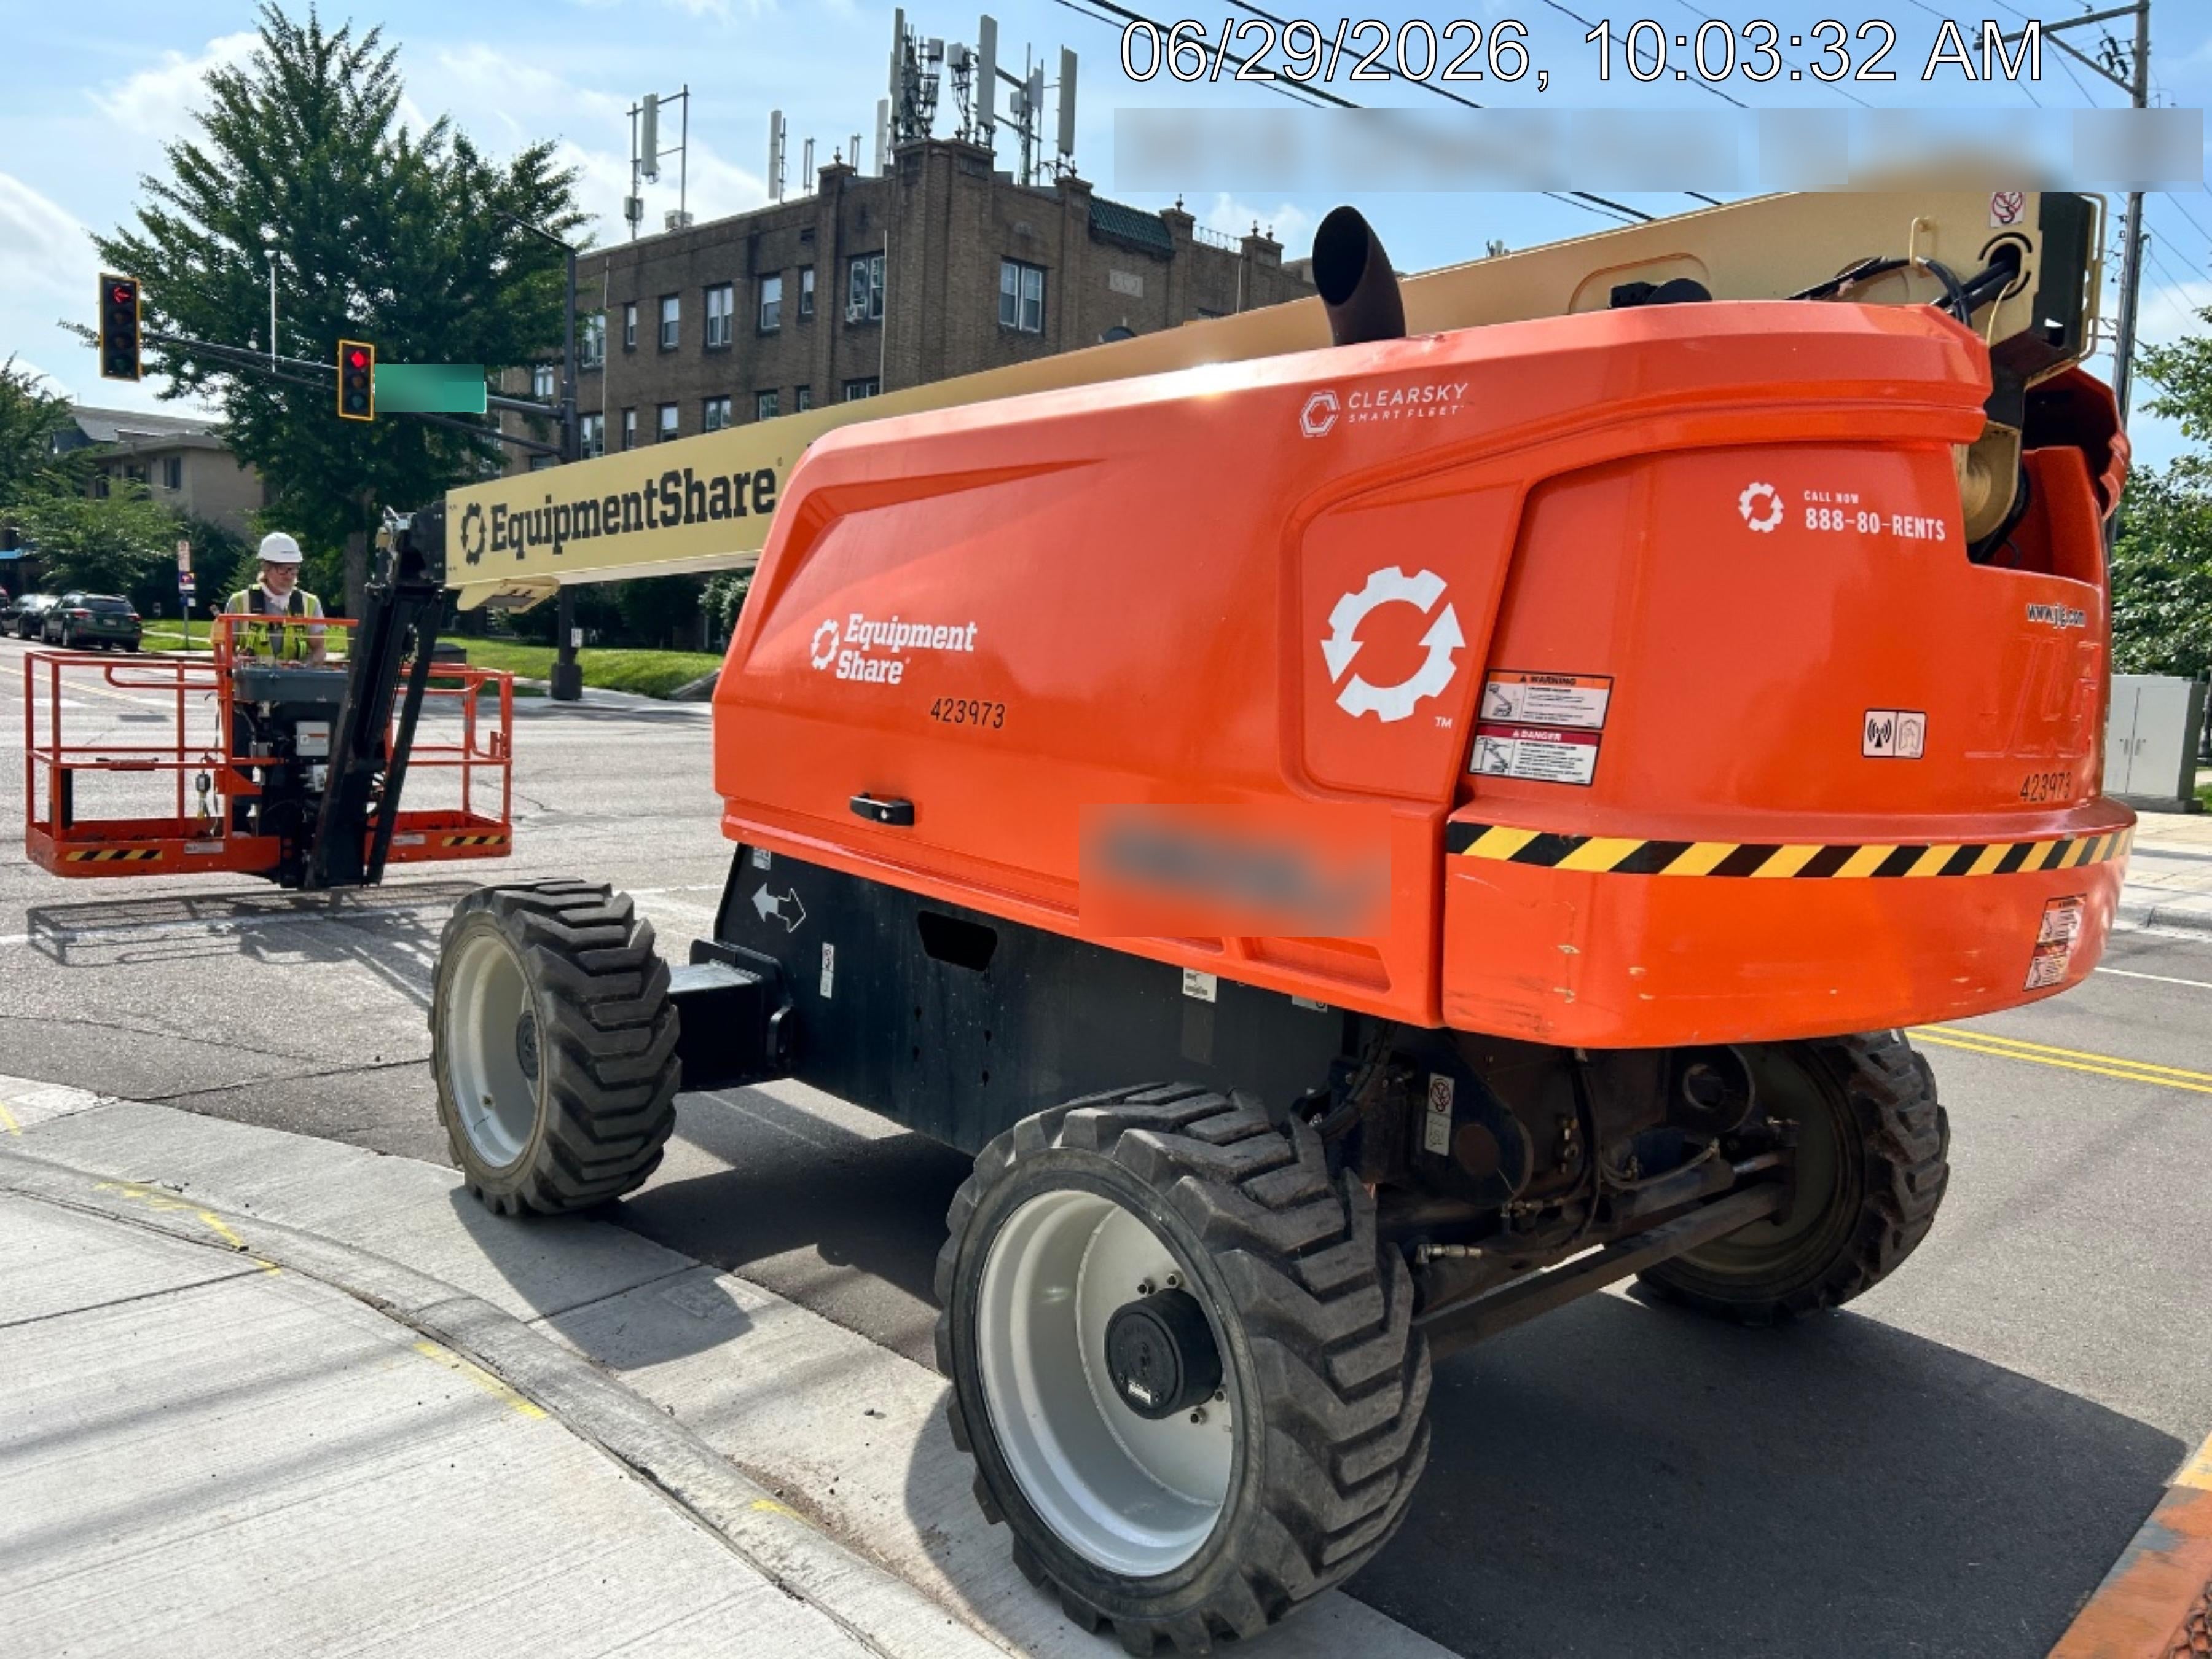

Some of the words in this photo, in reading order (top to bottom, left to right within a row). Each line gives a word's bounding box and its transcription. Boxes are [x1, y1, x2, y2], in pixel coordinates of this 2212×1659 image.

[1348, 383, 1468, 409] CLEARSKY
[1348, 411, 1400, 423] SMART
[1804, 490, 1831, 502] CALL
[1835, 493, 1859, 504] NOW
[490, 467, 777, 560] EquipmentShare
[1805, 507, 1945, 541] 888-80-RENTS
[844, 613, 977, 653] Equipment
[836, 650, 903, 684] Share
[930, 698, 1006, 729] 423973
[1435, 716, 1453, 728] TM
[2020, 771, 2071, 801] 423973
